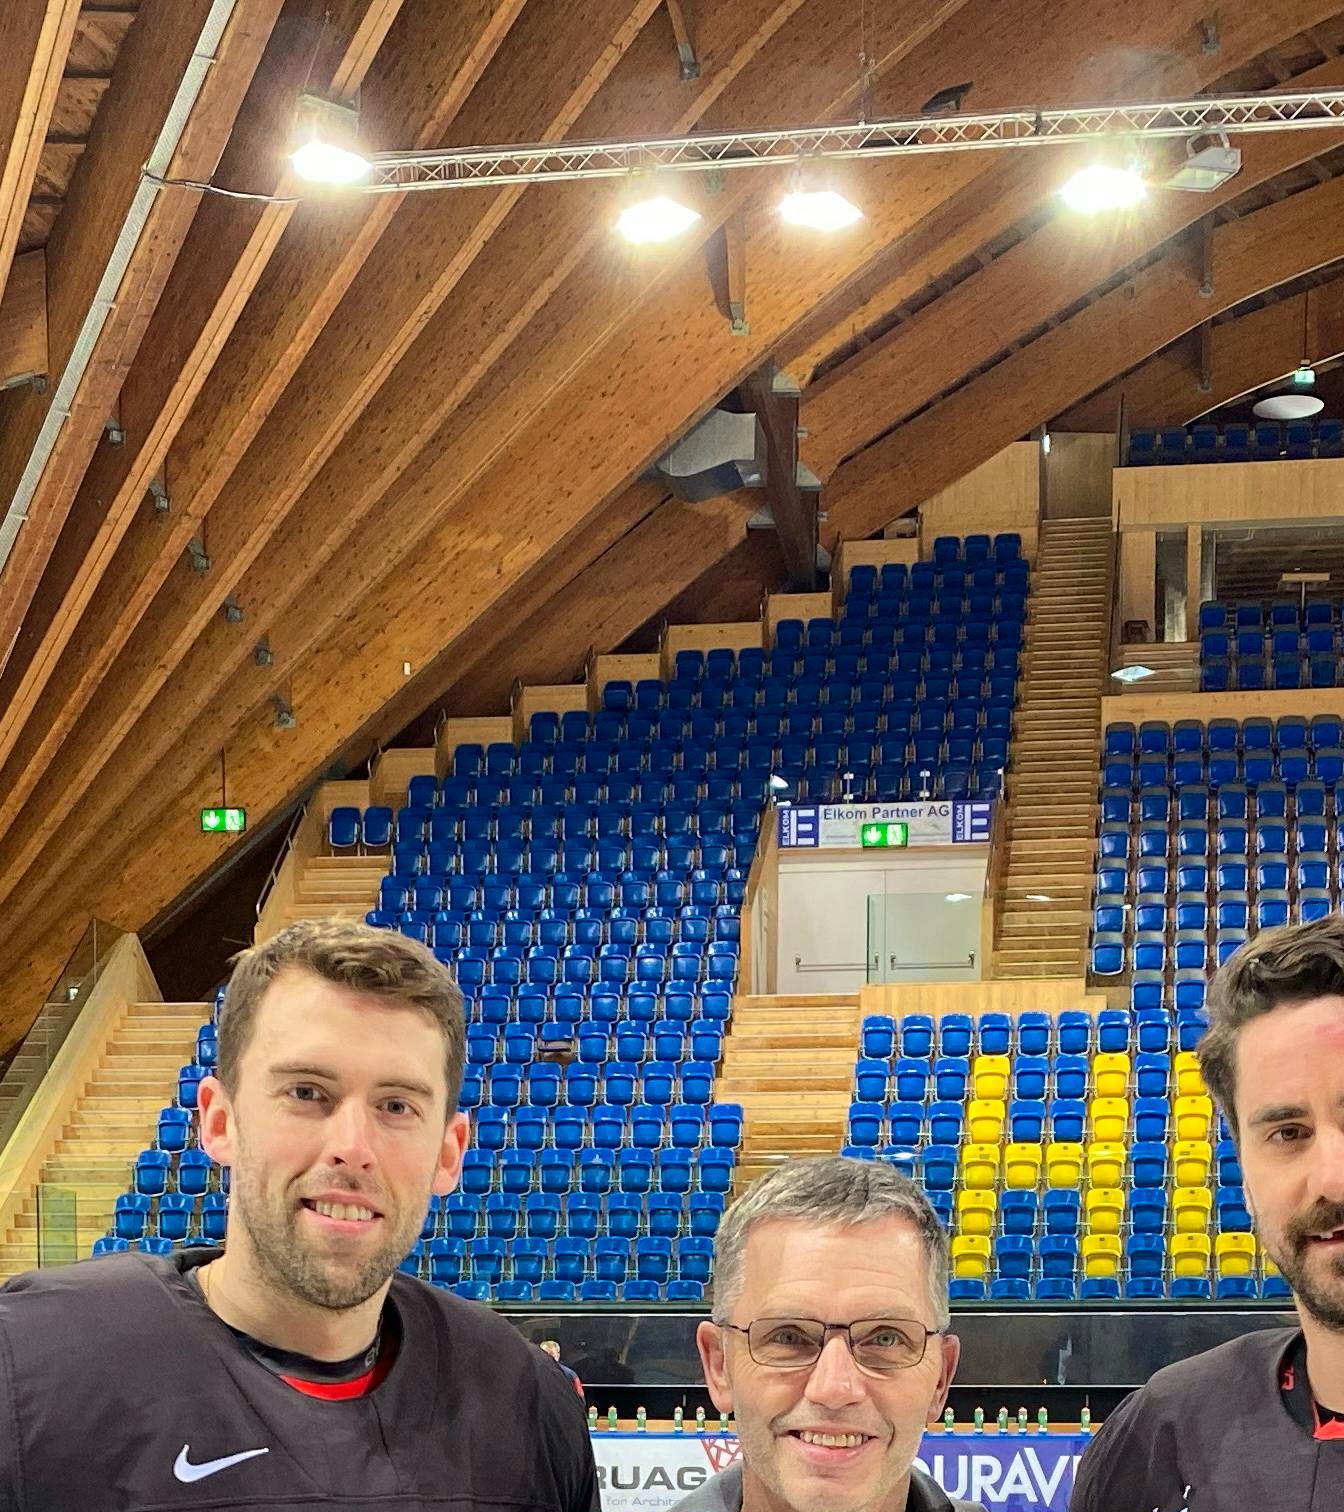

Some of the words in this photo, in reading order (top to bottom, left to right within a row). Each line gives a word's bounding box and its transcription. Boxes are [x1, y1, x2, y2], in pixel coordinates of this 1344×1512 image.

[823, 808, 867, 821] Elkom
[872, 806, 924, 820] Partner
[928, 804, 950, 818] AG
